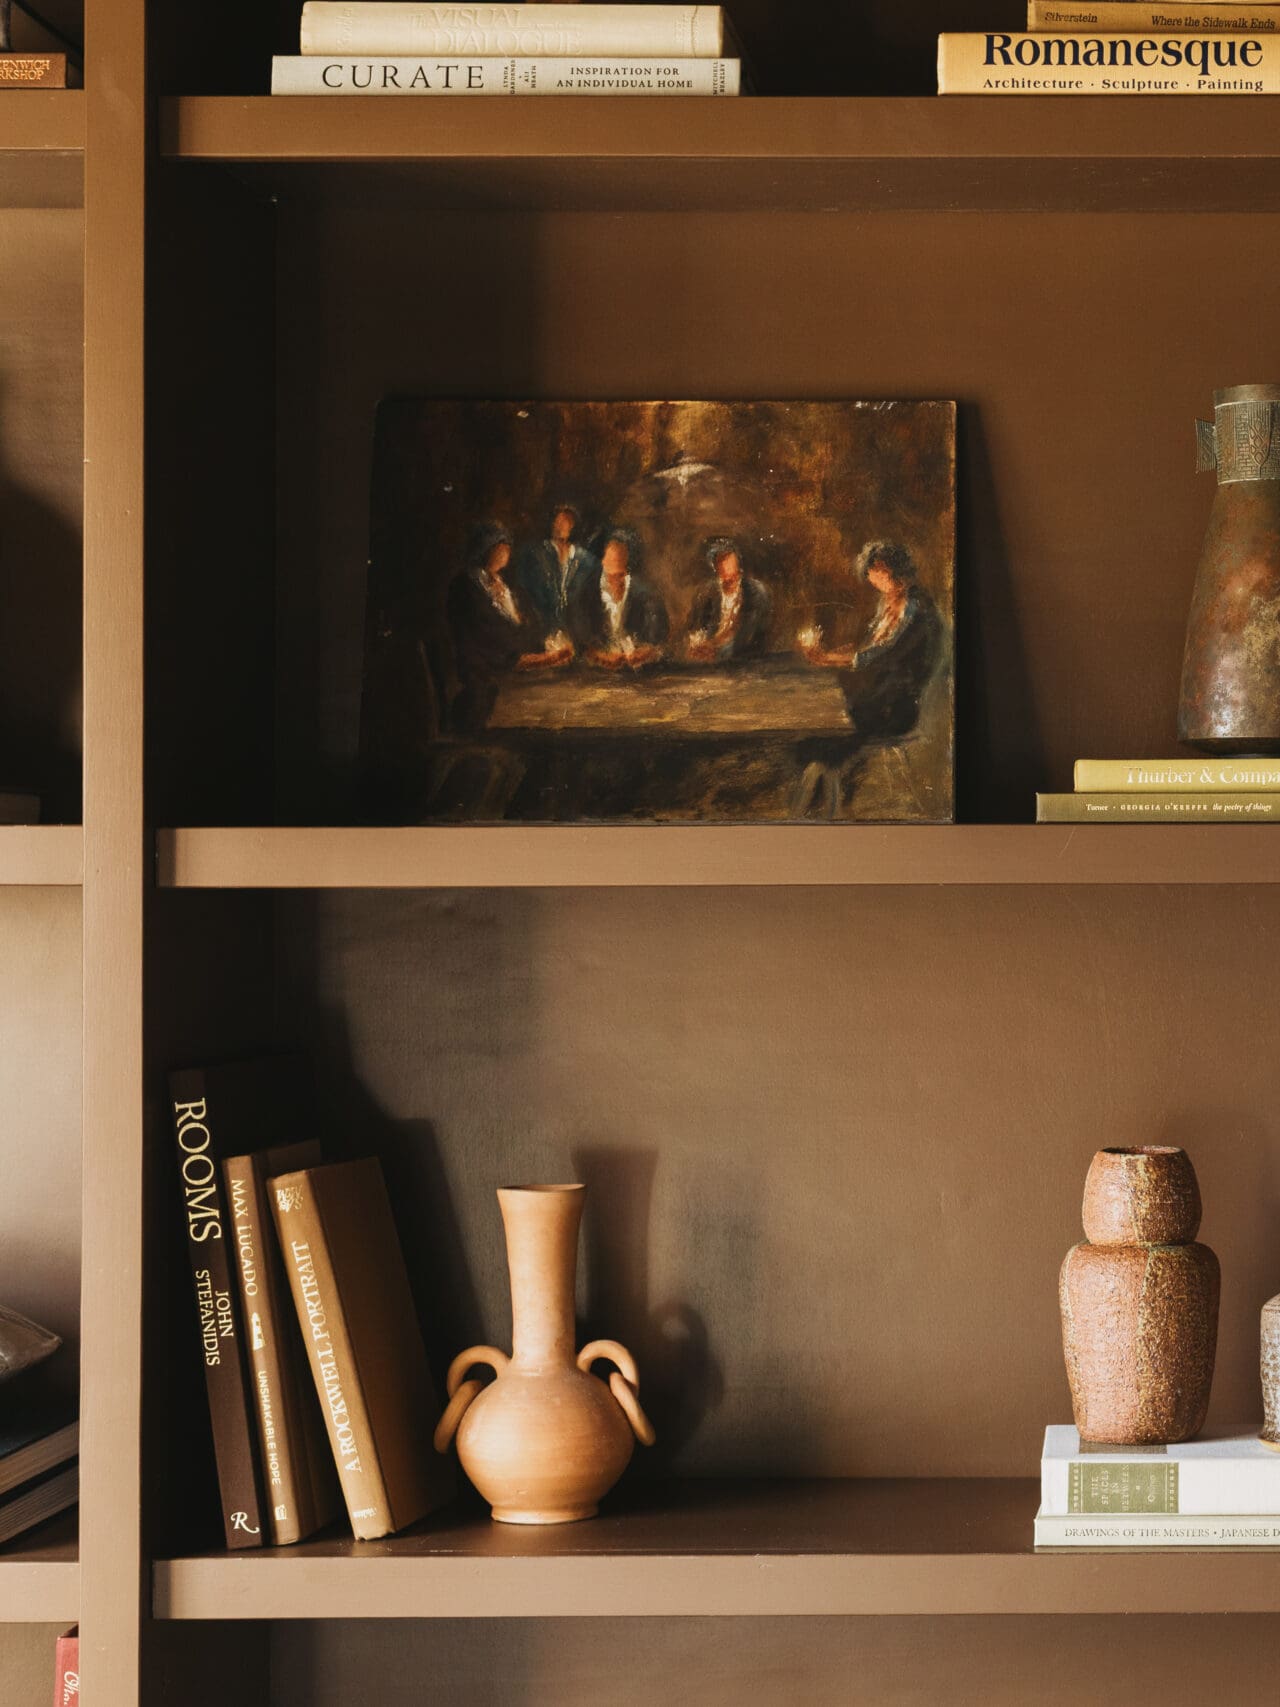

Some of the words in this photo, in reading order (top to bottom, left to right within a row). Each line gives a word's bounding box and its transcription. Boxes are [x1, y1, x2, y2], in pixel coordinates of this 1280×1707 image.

[431, 7, 523, 29] VISUAL
[1044, 11, 1098, 23] Silverstein
[1151, 15, 1182, 27] Where
[1184, 16, 1199, 28] the
[1202, 17, 1248, 29] Sidewalk
[1250, 18, 1276, 30] Ends
[432, 29, 584, 56] DIALOGUE
[0, 60, 50, 70] ENWICH
[983, 34, 1263, 76] Romanesque
[321, 64, 486, 90] CURATE
[570, 66, 652, 77] INSPIRATION
[656, 66, 680, 77] FOR
[556, 79, 573, 89] AN
[577, 79, 653, 89] INDIVIDUAL
[657, 79, 693, 89] HOME
[983, 78, 1083, 90] Architecture
[1101, 78, 1178, 92] Sculpture
[1198, 78, 1264, 92] Painting
[1124, 767, 1196, 784] Thurber
[1200, 767, 1215, 784] &
[1086, 803, 1109, 811] Turner
[1212, 803, 1223, 811] the
[1223, 803, 1243, 813] poetry
[1244, 803, 1252, 813] of
[1252, 803, 1273, 813] things
[174, 1098, 222, 1242] ROOMS
[231, 1178, 248, 1219] MAX
[237, 1224, 257, 1297] LUCADO
[291, 1240, 328, 1342] PORTRAIT
[195, 1269, 220, 1367] STEFANIDIS
[215, 1290, 234, 1338] JOHN
[317, 1343, 358, 1459] ROCKWELL
[257, 1370, 275, 1448] UNSHAKABLE
[268, 1451, 281, 1486] HOPE
[344, 1457, 362, 1474] A
[1064, 1527, 1120, 1538] DRAWINGS
[1122, 1527, 1137, 1538] OF
[1138, 1527, 1161, 1538] THE
[1163, 1527, 1210, 1538] MASTERS
[1219, 1527, 1270, 1538] JAPANESE
